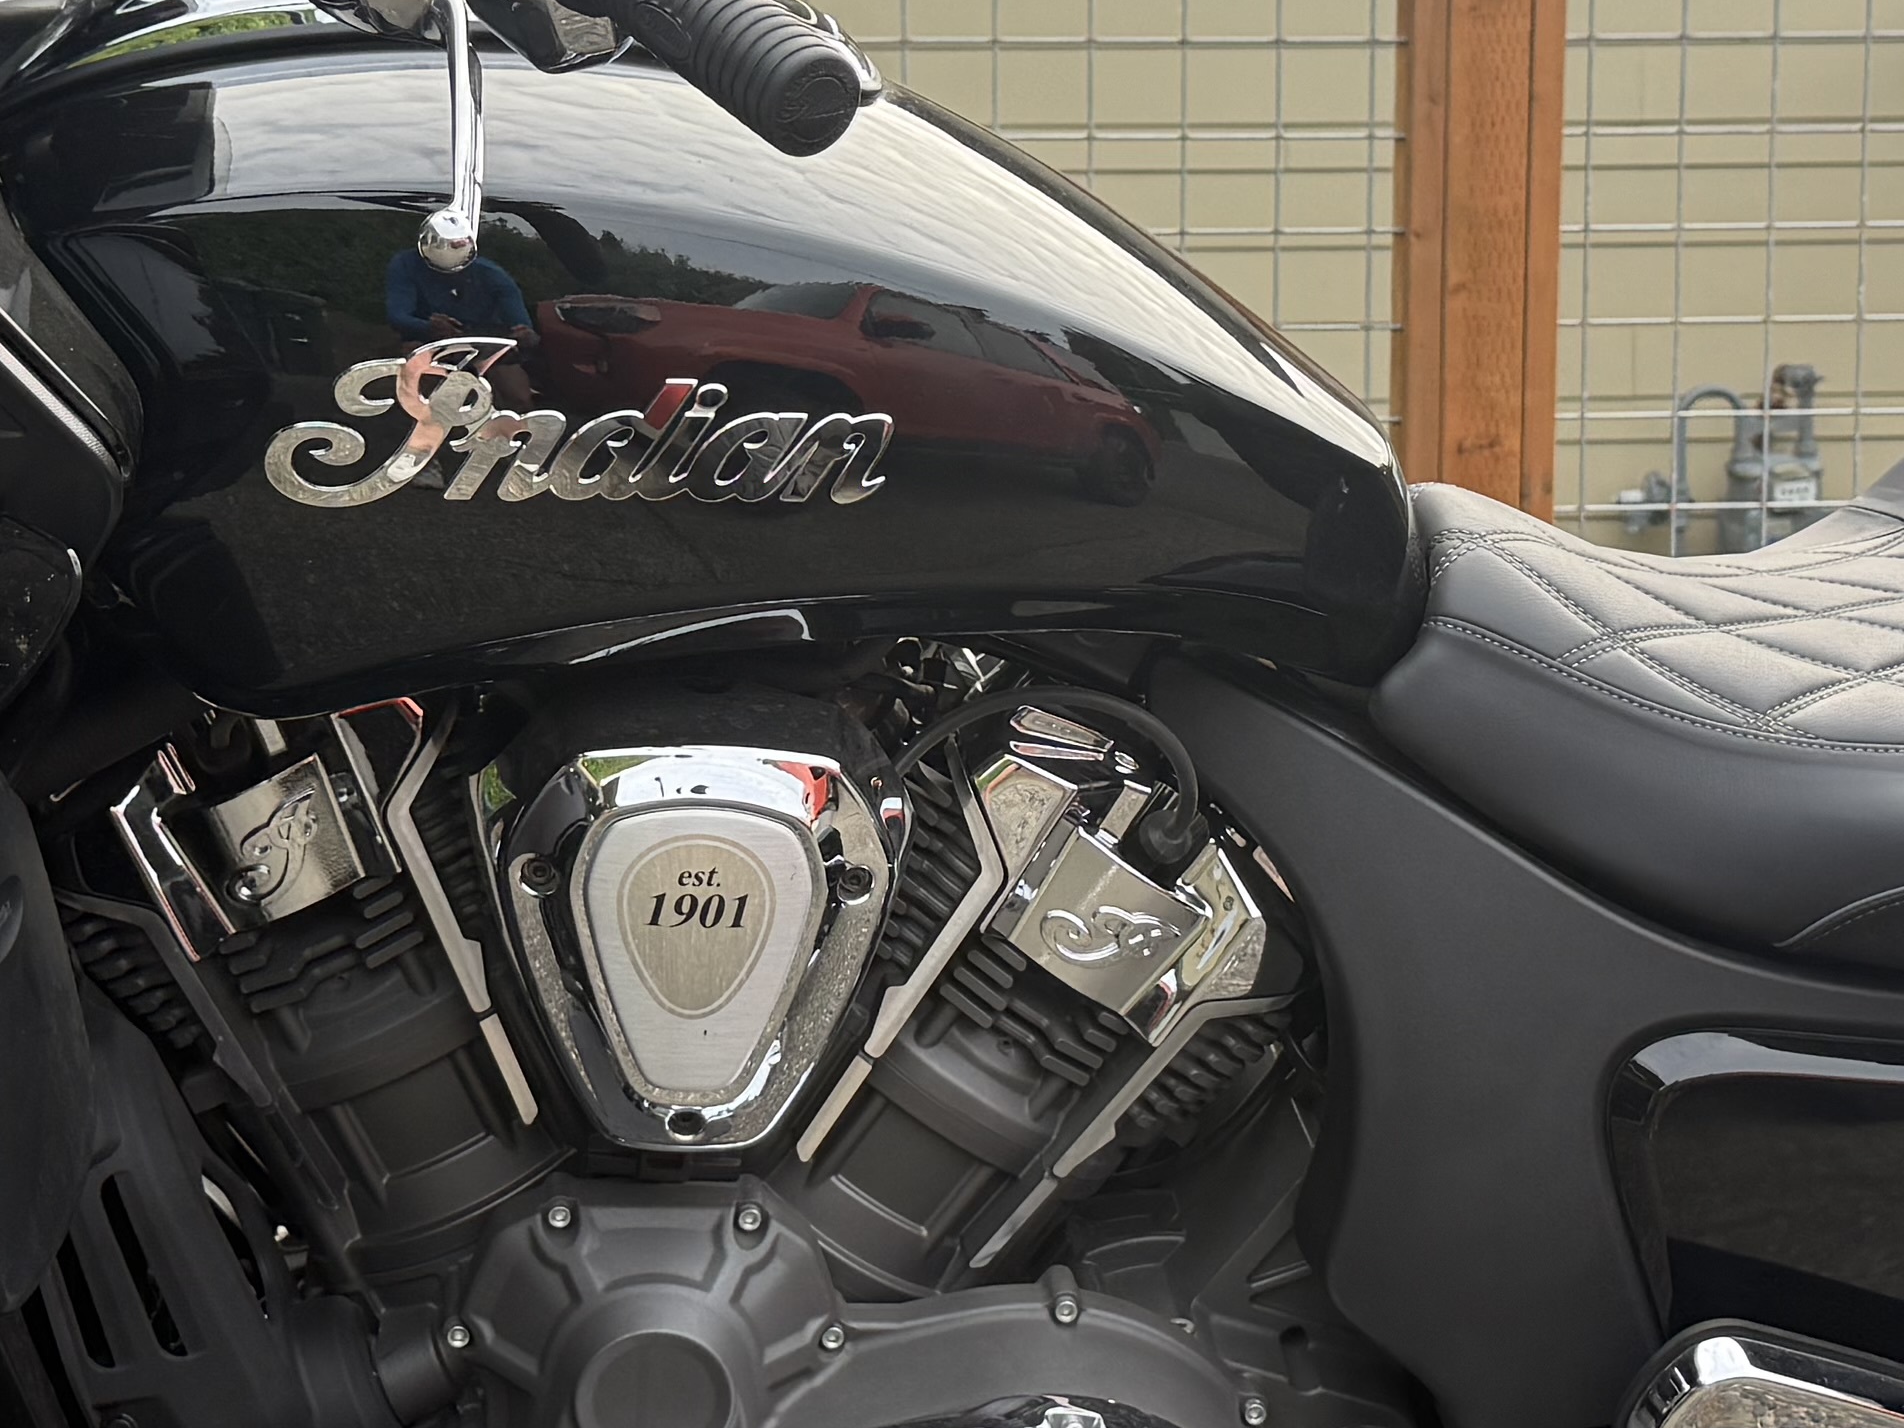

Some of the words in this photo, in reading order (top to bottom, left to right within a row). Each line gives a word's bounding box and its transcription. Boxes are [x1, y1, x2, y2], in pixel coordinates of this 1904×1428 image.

[264, 336, 894, 508] Indian
[677, 866, 721, 888] est.
[643, 892, 749, 929] 1901
